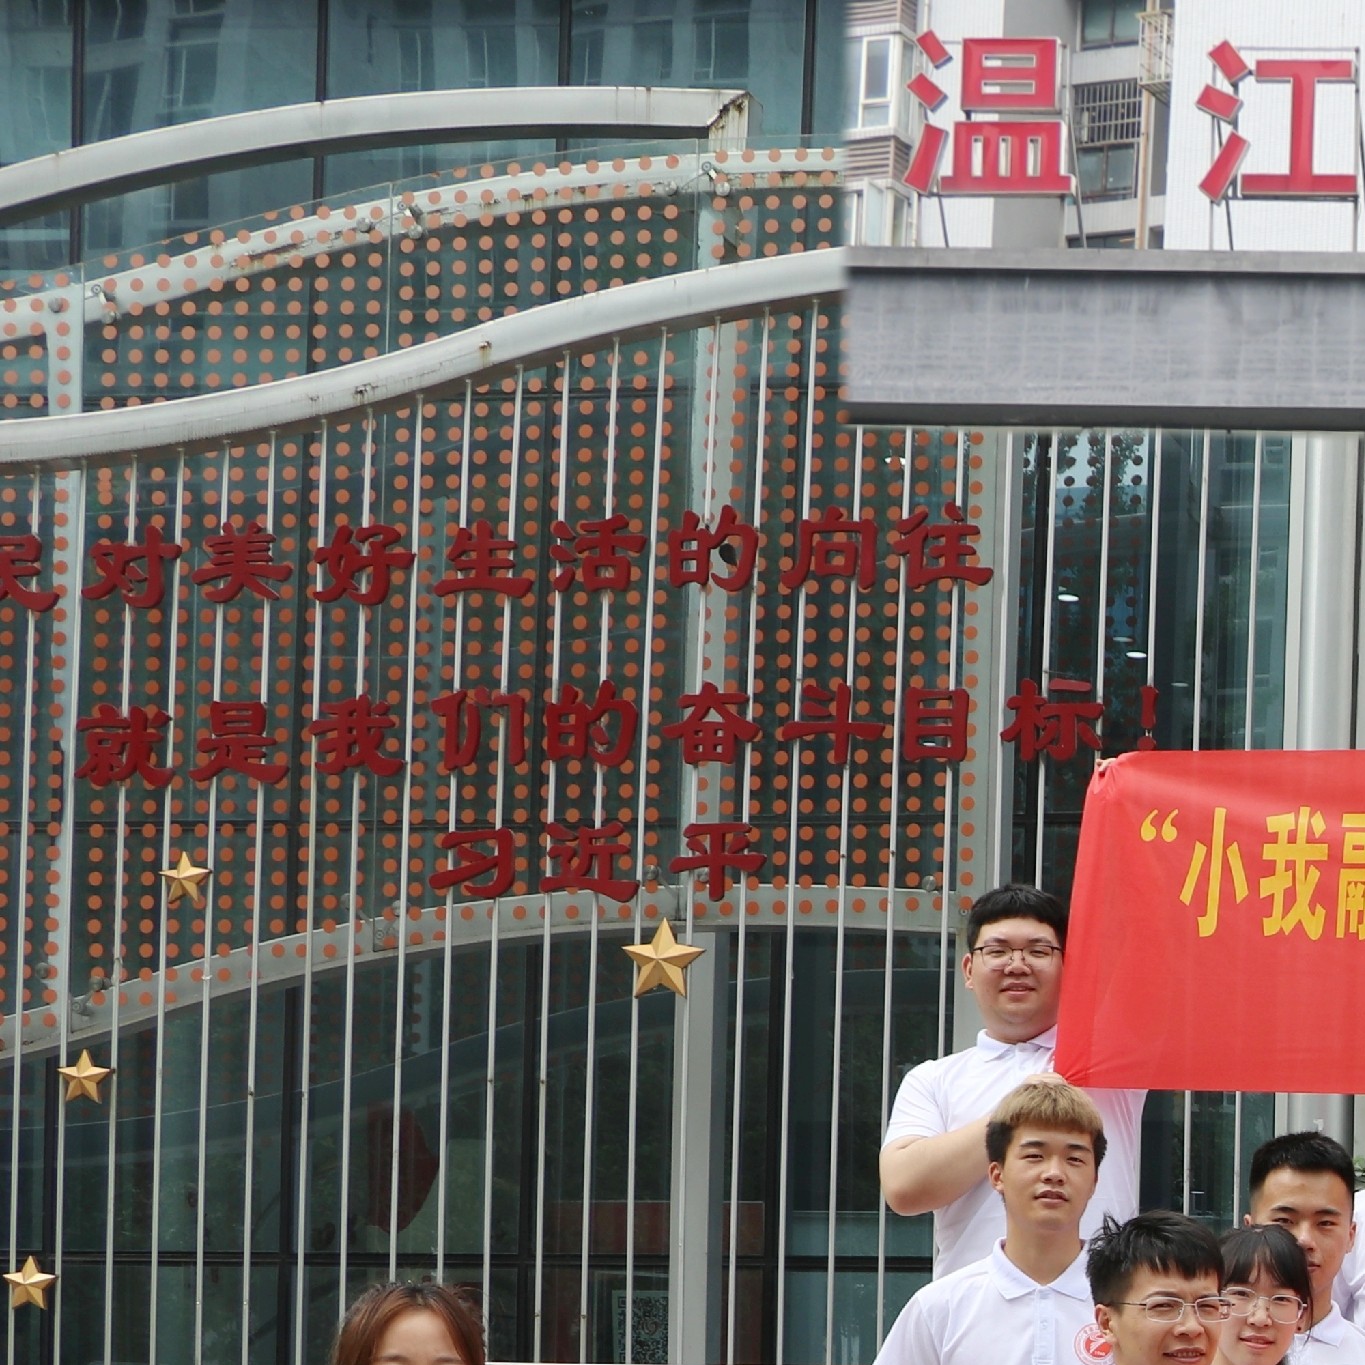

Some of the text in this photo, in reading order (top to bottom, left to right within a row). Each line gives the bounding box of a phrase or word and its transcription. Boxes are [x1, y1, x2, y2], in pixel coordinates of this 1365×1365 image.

[75, 679, 1158, 789] 就是我们的奋斗目标!
[428, 822, 767, 903] 习近平
